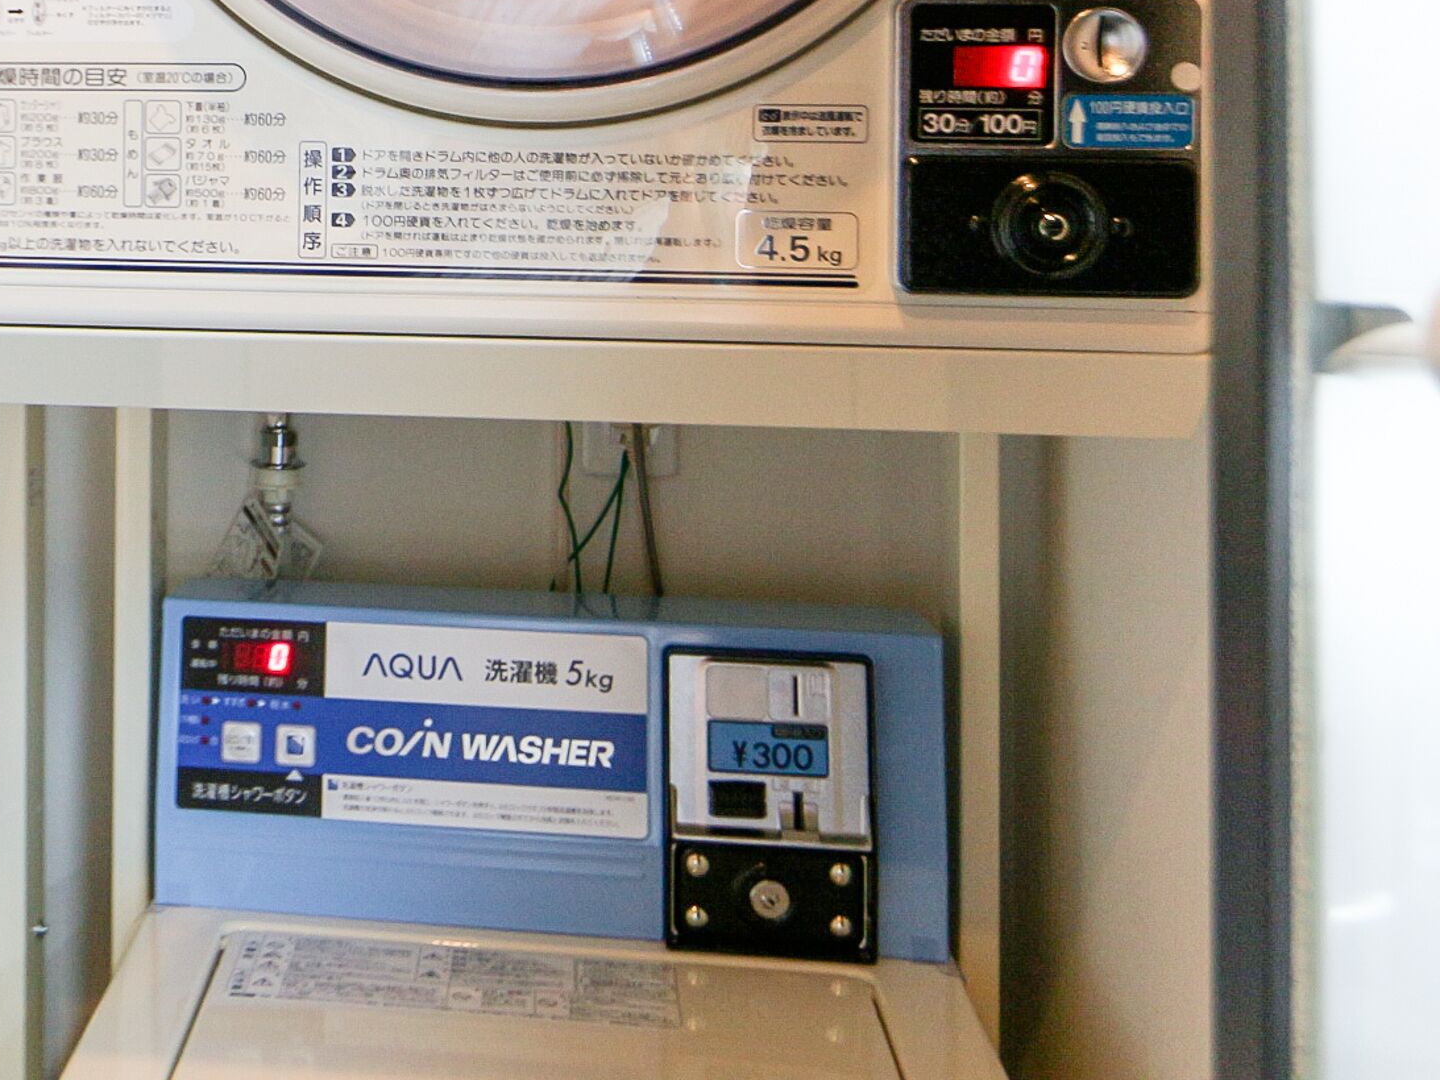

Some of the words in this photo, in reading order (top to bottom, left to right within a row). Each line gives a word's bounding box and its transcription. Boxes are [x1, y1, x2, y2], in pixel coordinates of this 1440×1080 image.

[1011, 49, 1041, 83] 0
[243, 112, 287, 127] 約60分
[243, 149, 287, 165] 約60分
[267, 642, 291, 672] 0
[362, 651, 464, 682] AQUA
[484, 658, 558, 686] 洗濯機
[461, 733, 616, 770] WASHER
[733, 739, 814, 771] ¥300
